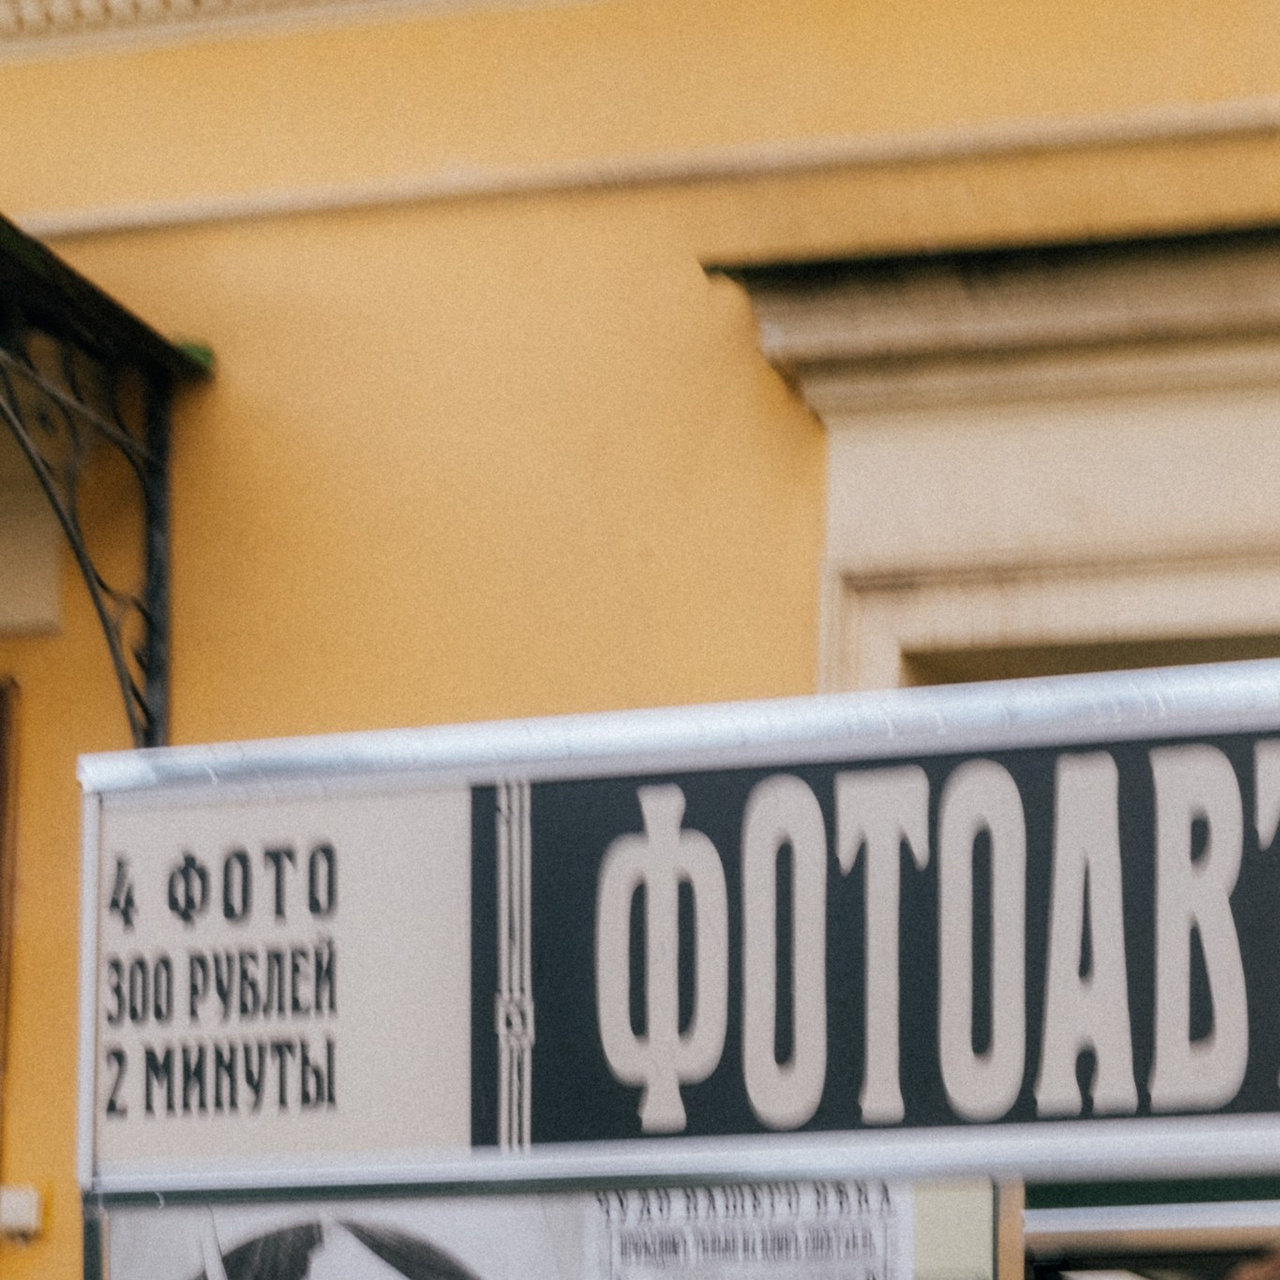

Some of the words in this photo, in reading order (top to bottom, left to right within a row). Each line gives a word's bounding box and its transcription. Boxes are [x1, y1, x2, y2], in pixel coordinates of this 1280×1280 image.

[108, 855, 137, 930] 4
[167, 840, 338, 928] ФОТО
[106, 953, 174, 1028] 300
[188, 936, 337, 1022] РУБЛЕЙ
[105, 1045, 128, 1117] 2
[144, 1032, 337, 1117] МИНУТЫ
